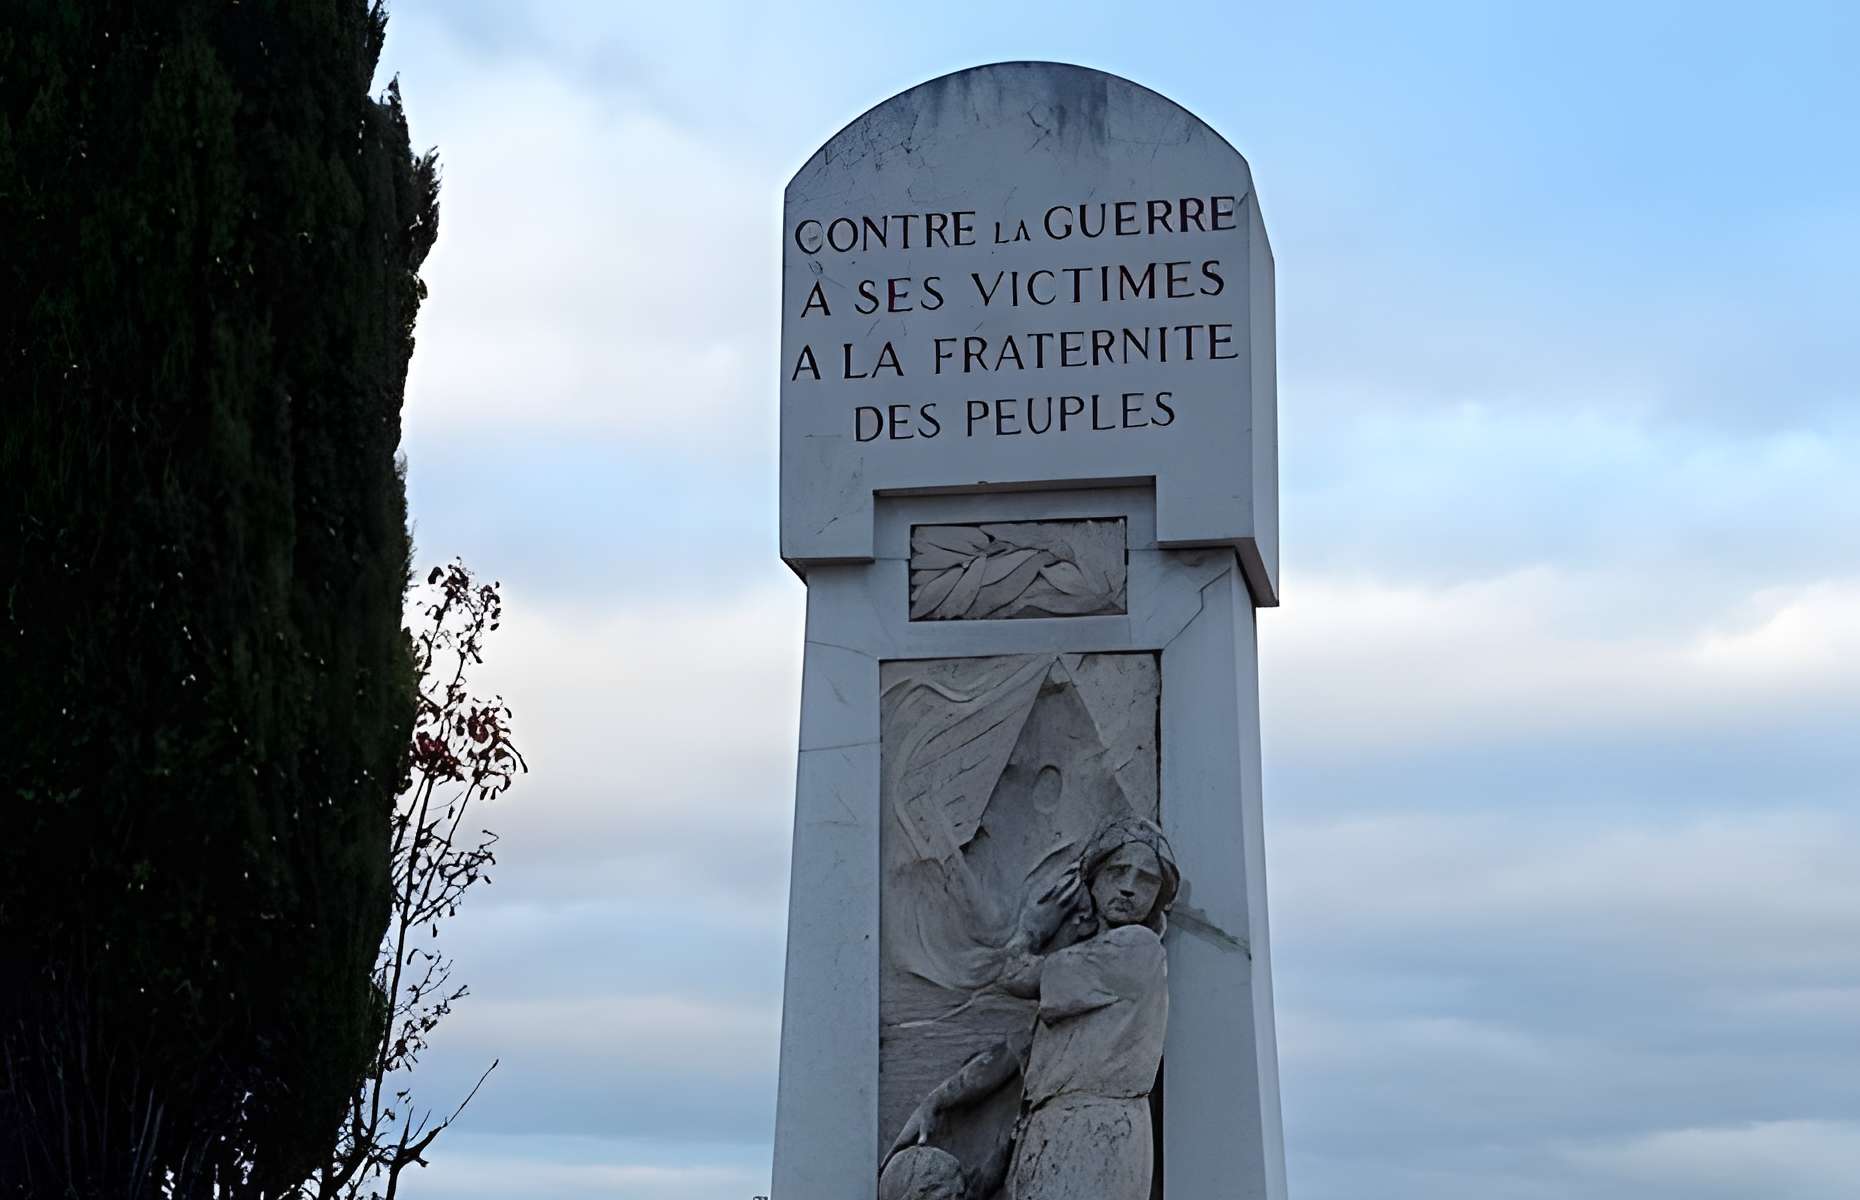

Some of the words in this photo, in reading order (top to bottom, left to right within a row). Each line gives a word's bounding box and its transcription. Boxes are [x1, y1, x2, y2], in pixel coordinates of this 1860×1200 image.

[794, 210, 976, 255] CONTRE
[994, 219, 1031, 244] LA
[1043, 196, 1237, 240] GUERRE
[800, 280, 831, 319] A
[854, 276, 944, 315] SES
[971, 260, 1225, 307] VICTIMES
[791, 344, 821, 382] A
[843, 341, 905, 379] LA
[933, 323, 1239, 375] FRATERNITE
[855, 402, 941, 443] DES
[966, 391, 1175, 437] PEUPLES
